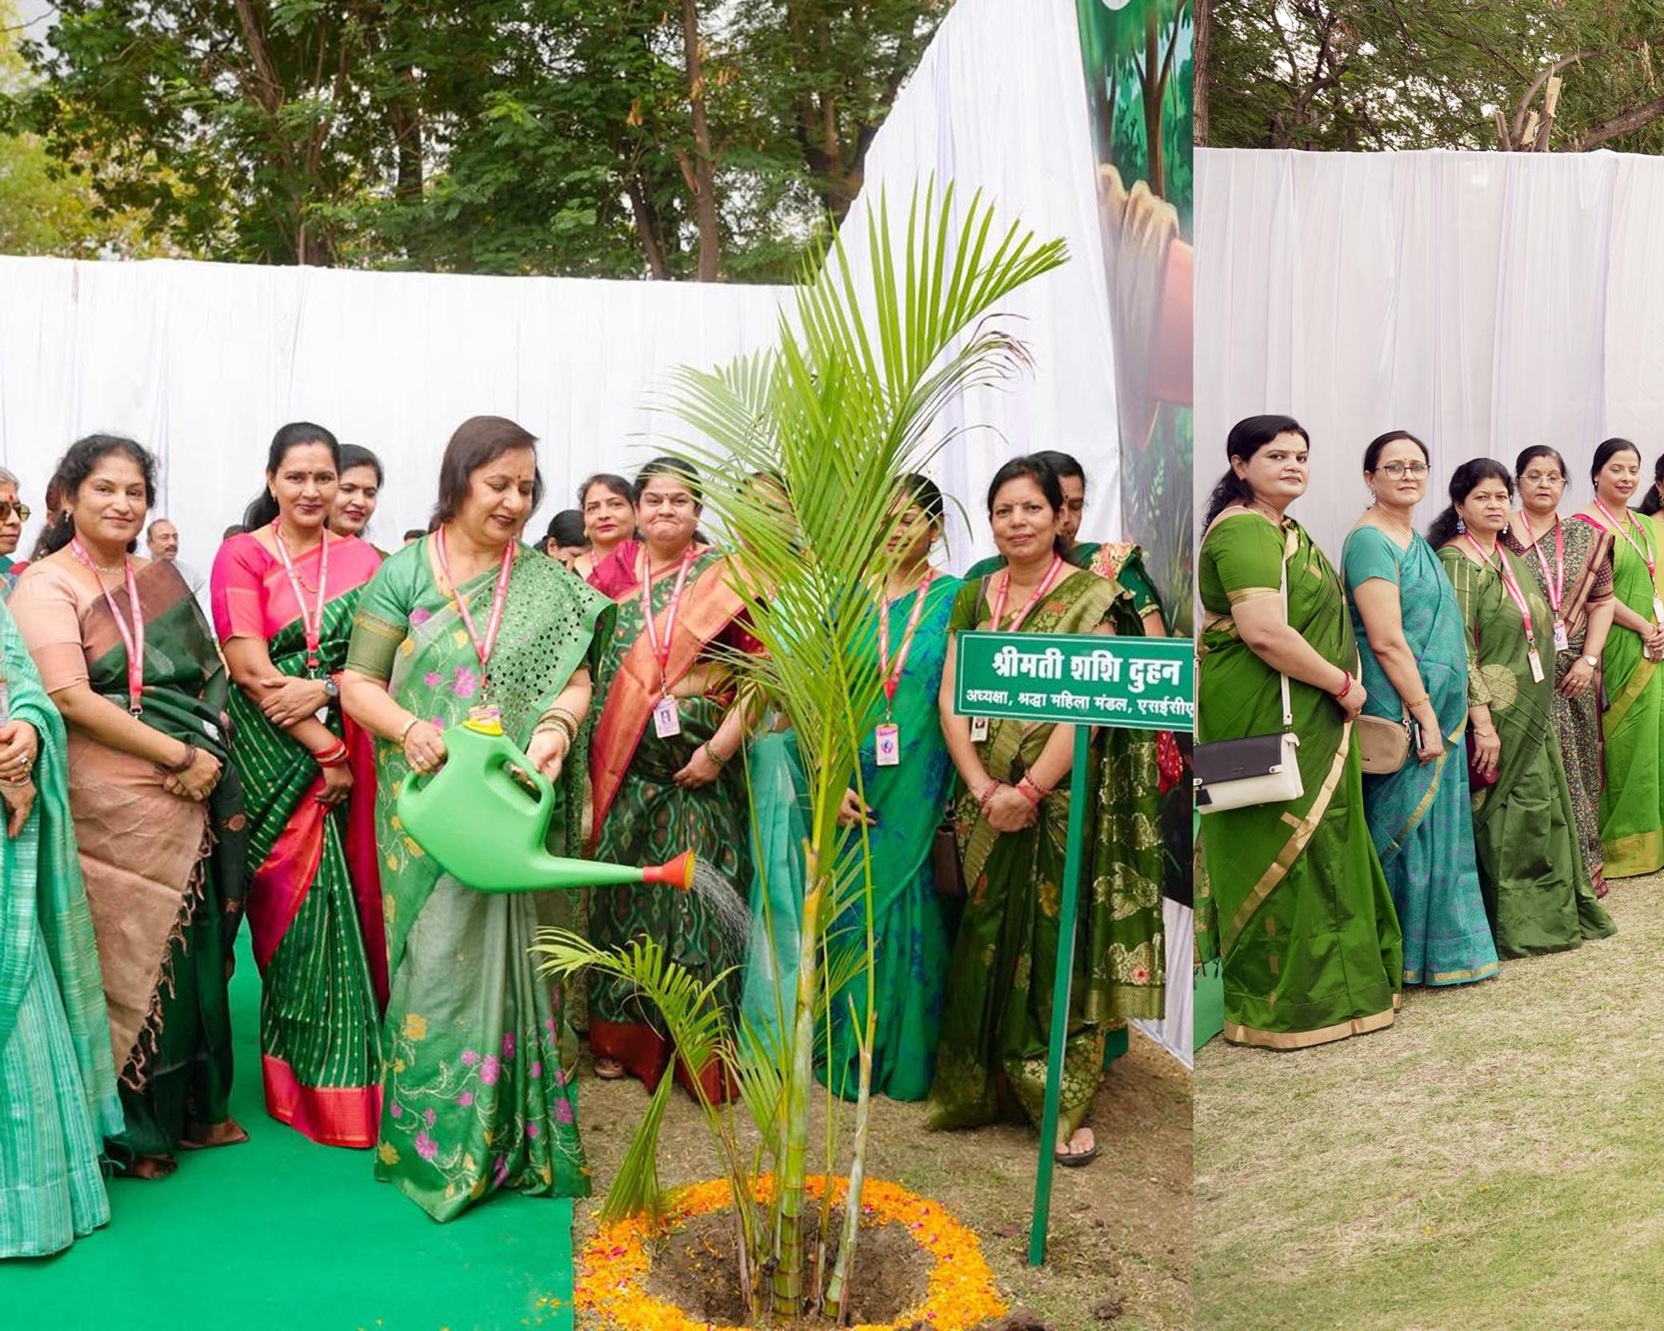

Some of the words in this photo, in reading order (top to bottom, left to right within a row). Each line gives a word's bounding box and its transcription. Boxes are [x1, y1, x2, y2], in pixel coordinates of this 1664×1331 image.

[992, 645, 1065, 680] श्रीमती
[1070, 650, 1123, 682] शशि
[1127, 658, 1183, 693] दुहन
[1018, 692, 1047, 708] श्रद्धा
[1050, 690, 1090, 710] महिला
[1093, 694, 1133, 714] मंडल,
[1136, 695, 1194, 718] एसईसीए
